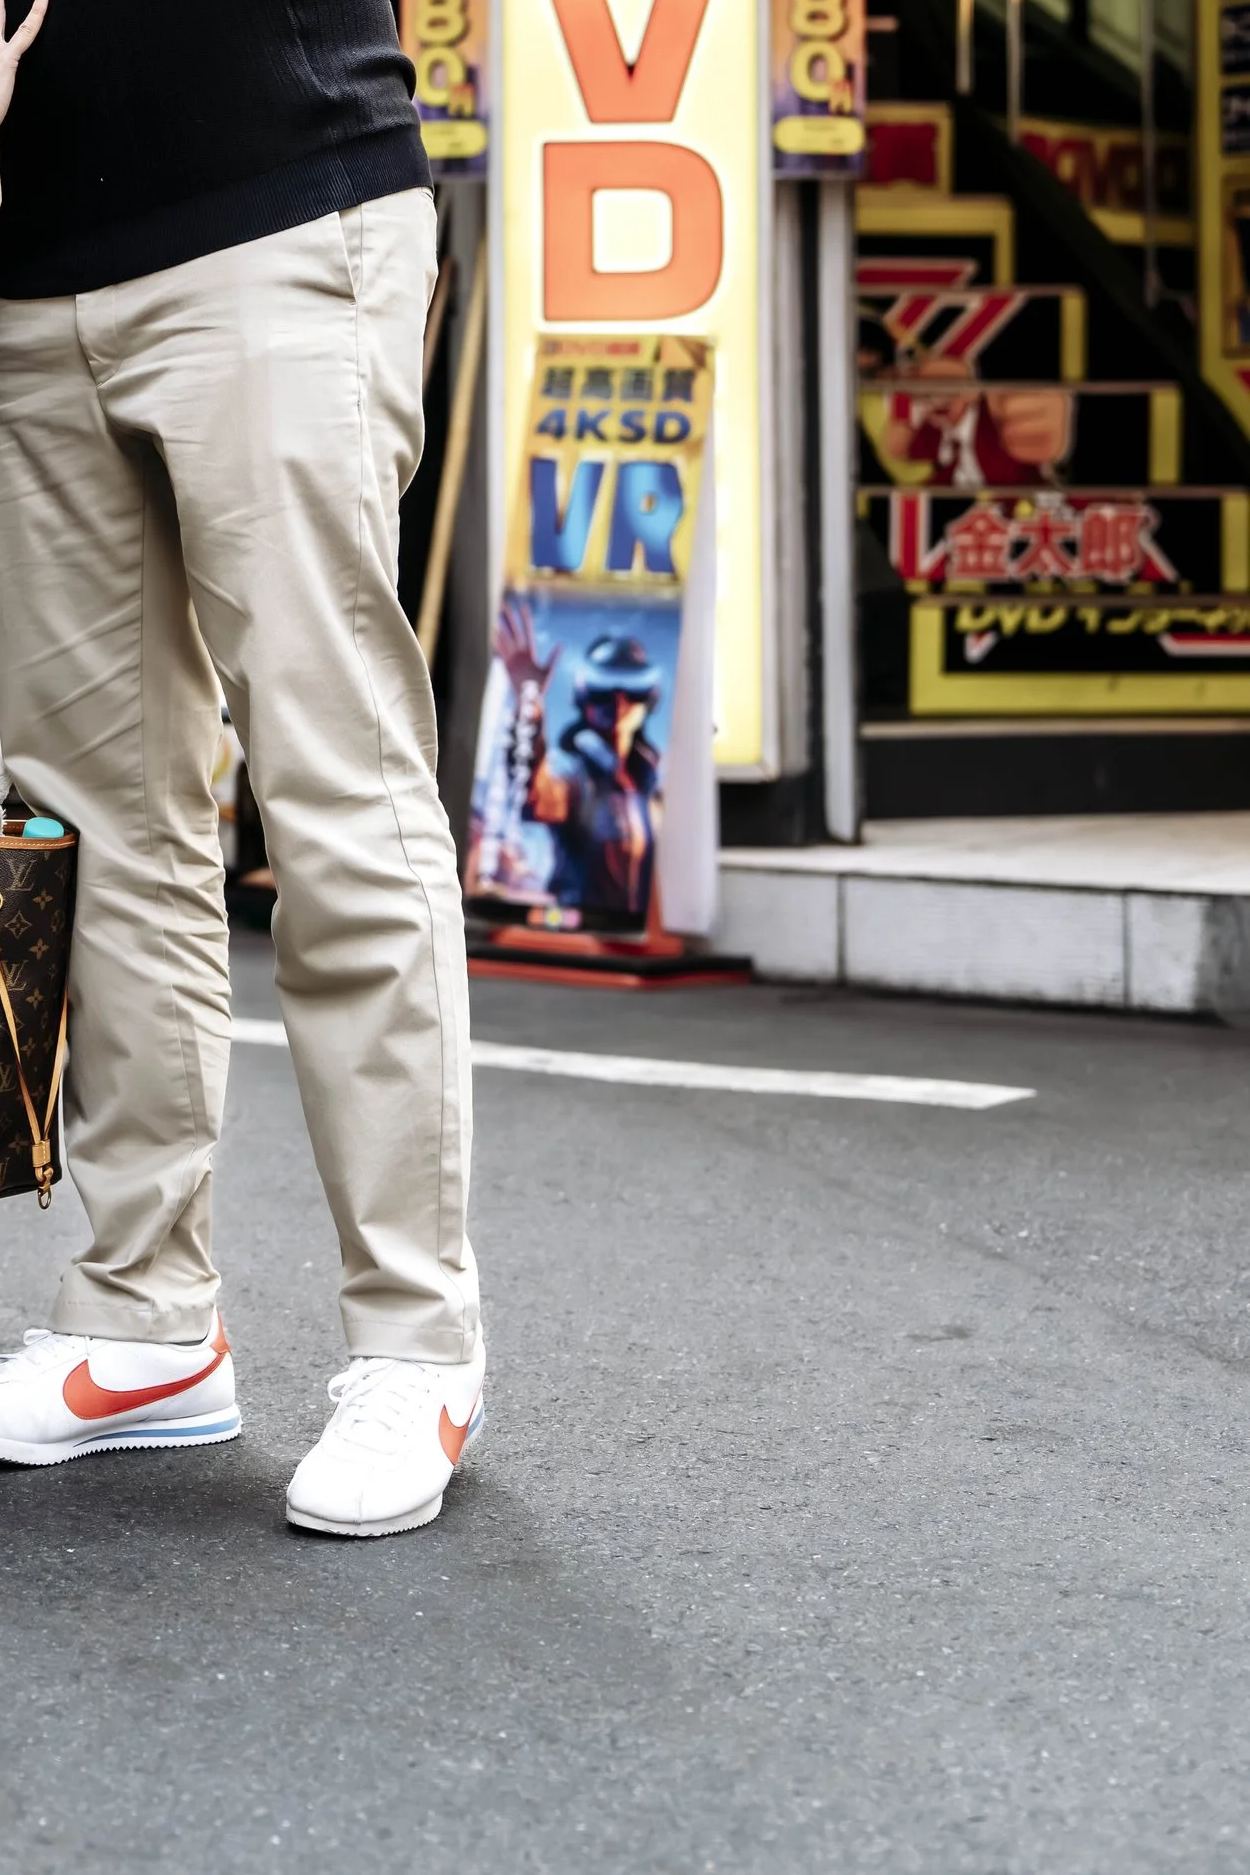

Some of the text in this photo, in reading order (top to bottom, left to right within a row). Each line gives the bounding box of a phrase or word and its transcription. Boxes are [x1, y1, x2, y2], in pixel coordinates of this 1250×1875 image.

[536, 408, 692, 444] 4KSD
[530, 456, 685, 573] VR
[947, 501, 1148, 581] 金太郎
